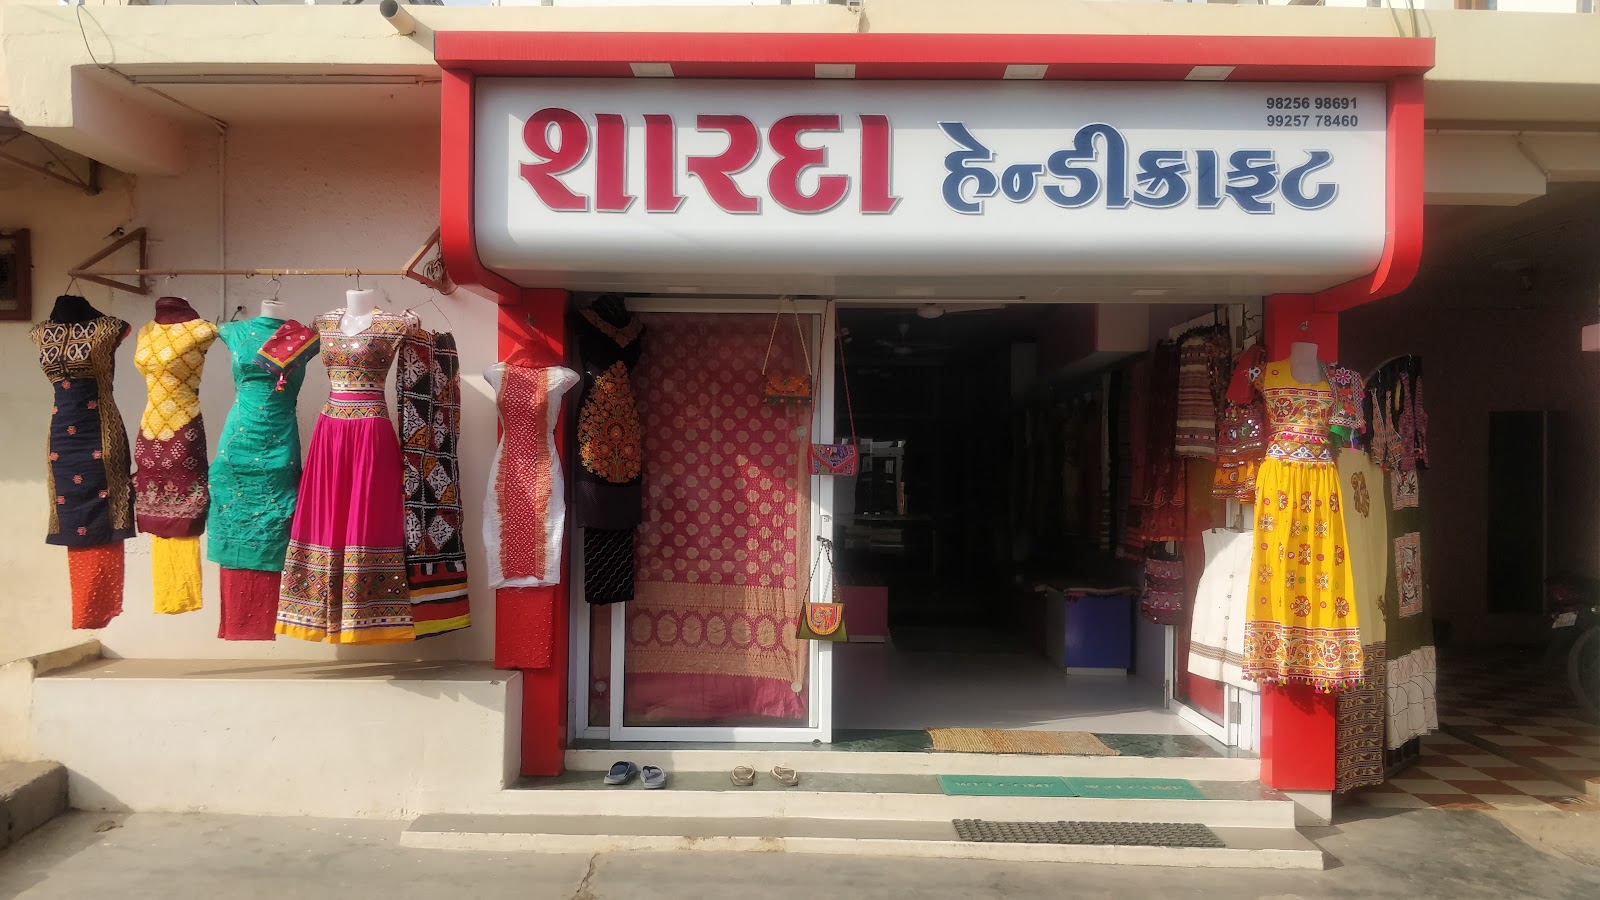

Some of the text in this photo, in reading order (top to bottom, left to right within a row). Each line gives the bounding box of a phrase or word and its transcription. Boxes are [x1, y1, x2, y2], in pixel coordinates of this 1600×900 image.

[1266, 97, 1357, 109] 98256 98691
[1266, 115, 1358, 127] 99257 78460
[518, 107, 903, 214] શારદા
